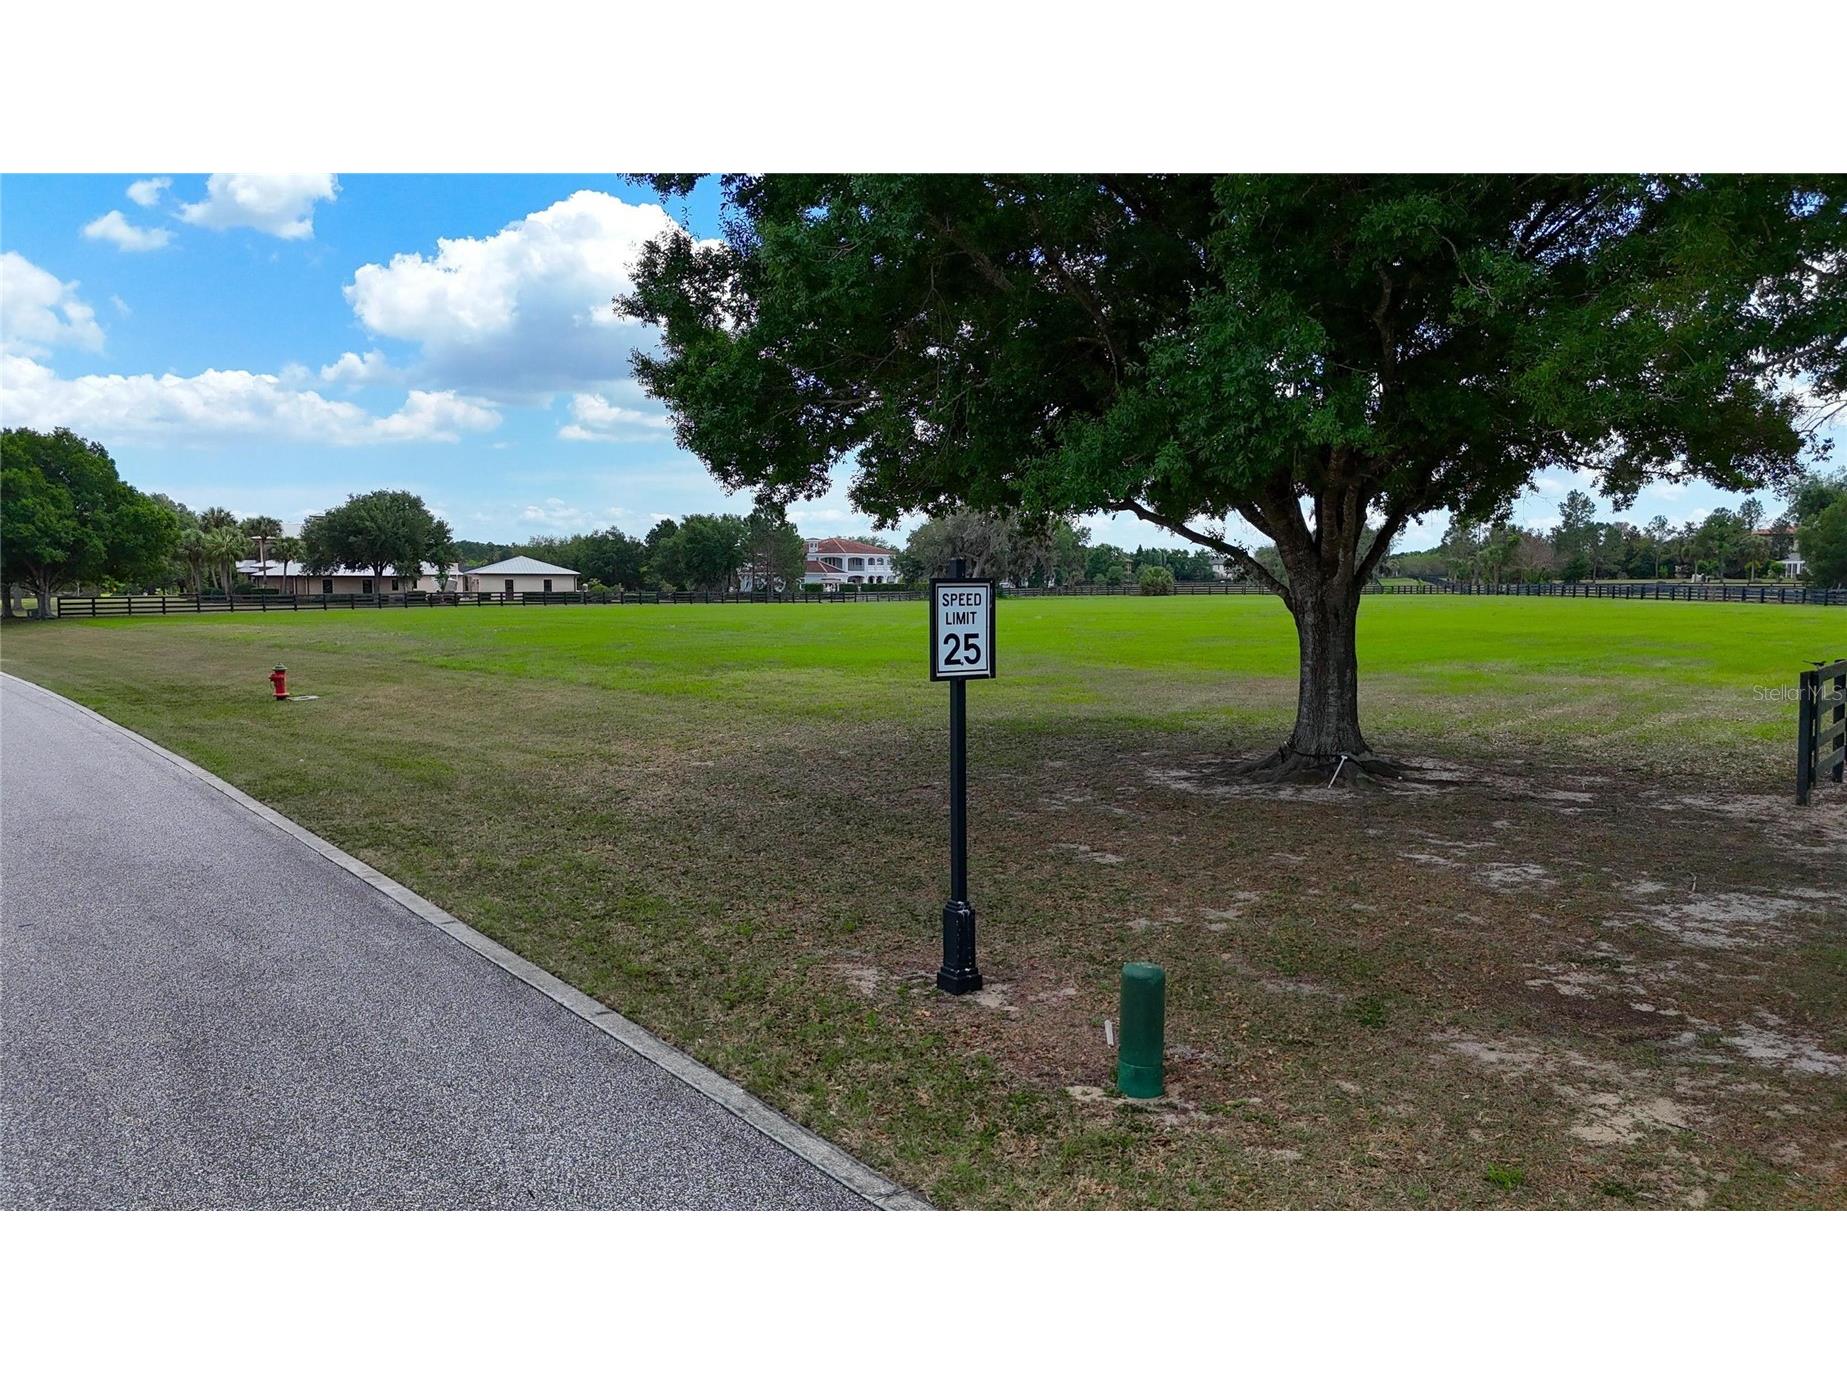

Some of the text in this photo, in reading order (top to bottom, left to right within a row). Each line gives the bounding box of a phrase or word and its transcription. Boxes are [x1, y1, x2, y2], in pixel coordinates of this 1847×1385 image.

[942, 593, 982, 607] SPEED
[945, 611, 977, 625] LIMIT
[943, 632, 982, 666] 25
